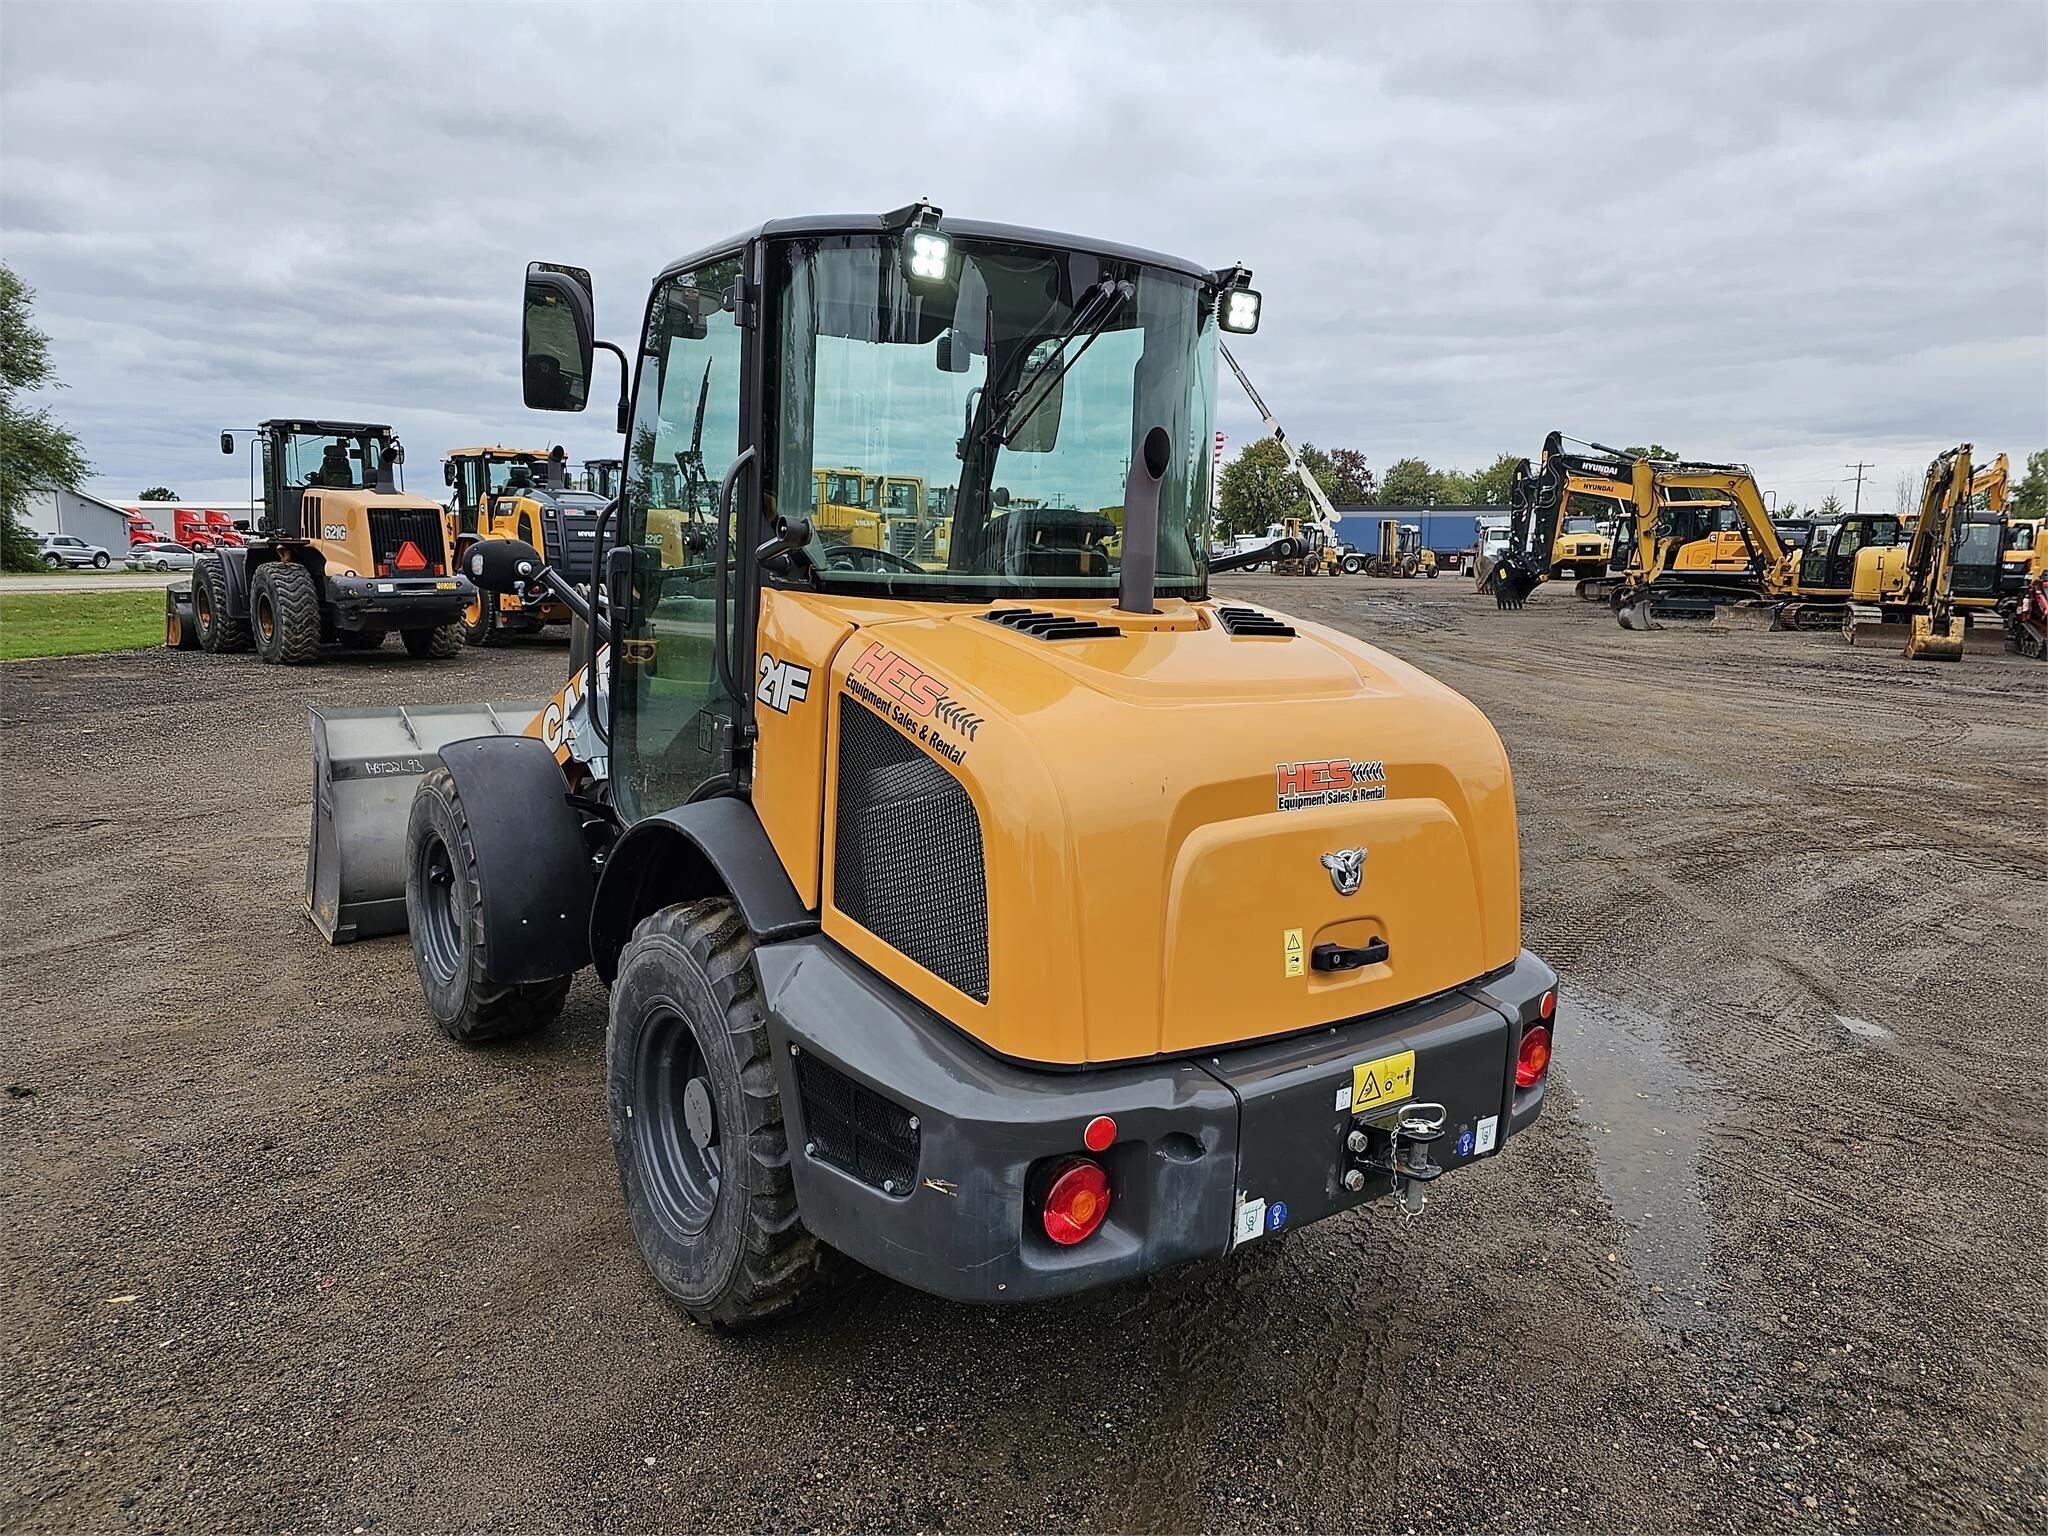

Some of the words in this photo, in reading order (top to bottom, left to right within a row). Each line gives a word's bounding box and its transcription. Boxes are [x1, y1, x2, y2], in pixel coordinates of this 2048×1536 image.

[1582, 462, 1618, 475] HYUNDAI
[1583, 483, 1614, 492] HYUNDAI
[324, 524, 347, 541] 621G
[757, 652, 812, 715] 21F
[852, 641, 948, 717] HES
[845, 672, 892, 716] Equipment
[891, 704, 918, 735] Sales
[918, 724, 928, 741] &
[928, 731, 967, 766] Rental
[1277, 760, 1354, 795] HES
[1278, 793, 1326, 811] Equipment
[1327, 790, 1350, 804] Sales
[1351, 789, 1359, 801] &
[1360, 786, 1385, 799] Rental
